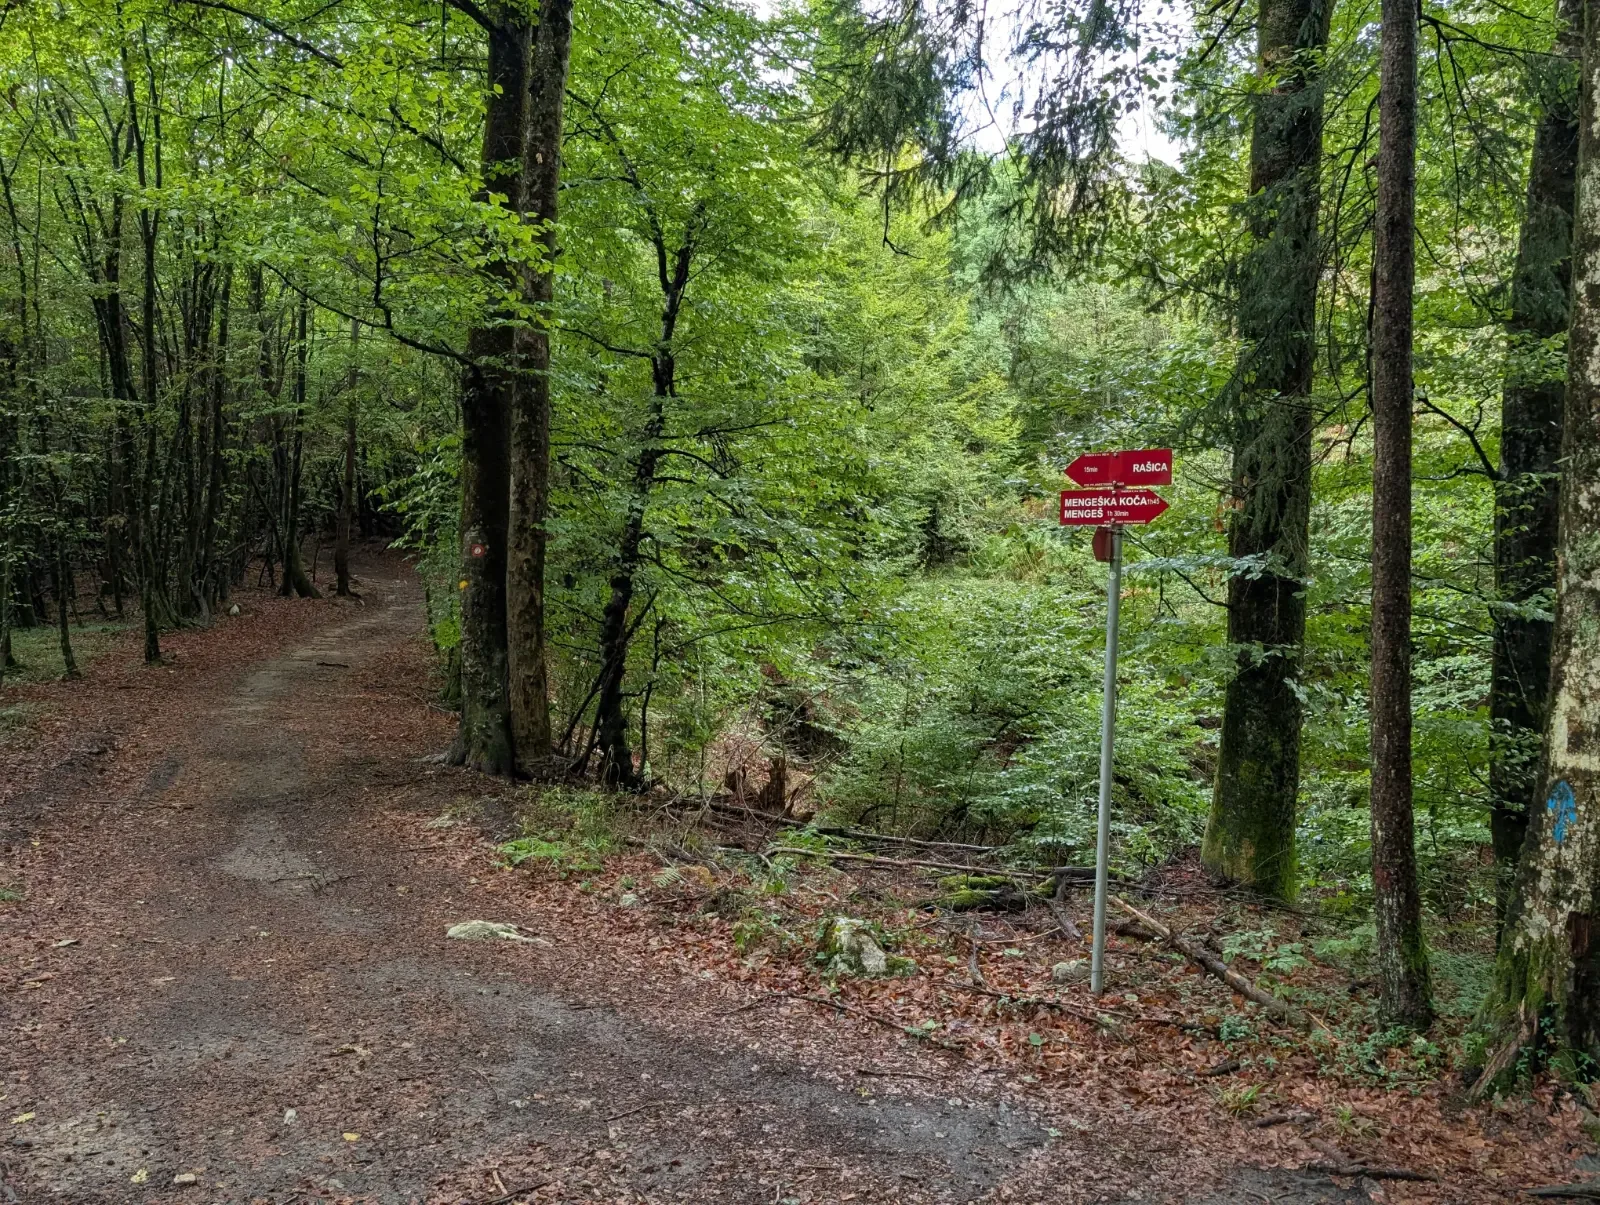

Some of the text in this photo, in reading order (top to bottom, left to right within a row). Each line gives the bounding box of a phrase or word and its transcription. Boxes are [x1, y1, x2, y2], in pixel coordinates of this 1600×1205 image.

[1132, 462, 1168, 472] RAŠICA
[1064, 496, 1117, 507] MENGEŠKA
[1120, 495, 1147, 506] KOČA
[1064, 508, 1103, 518] MENGEŠ
